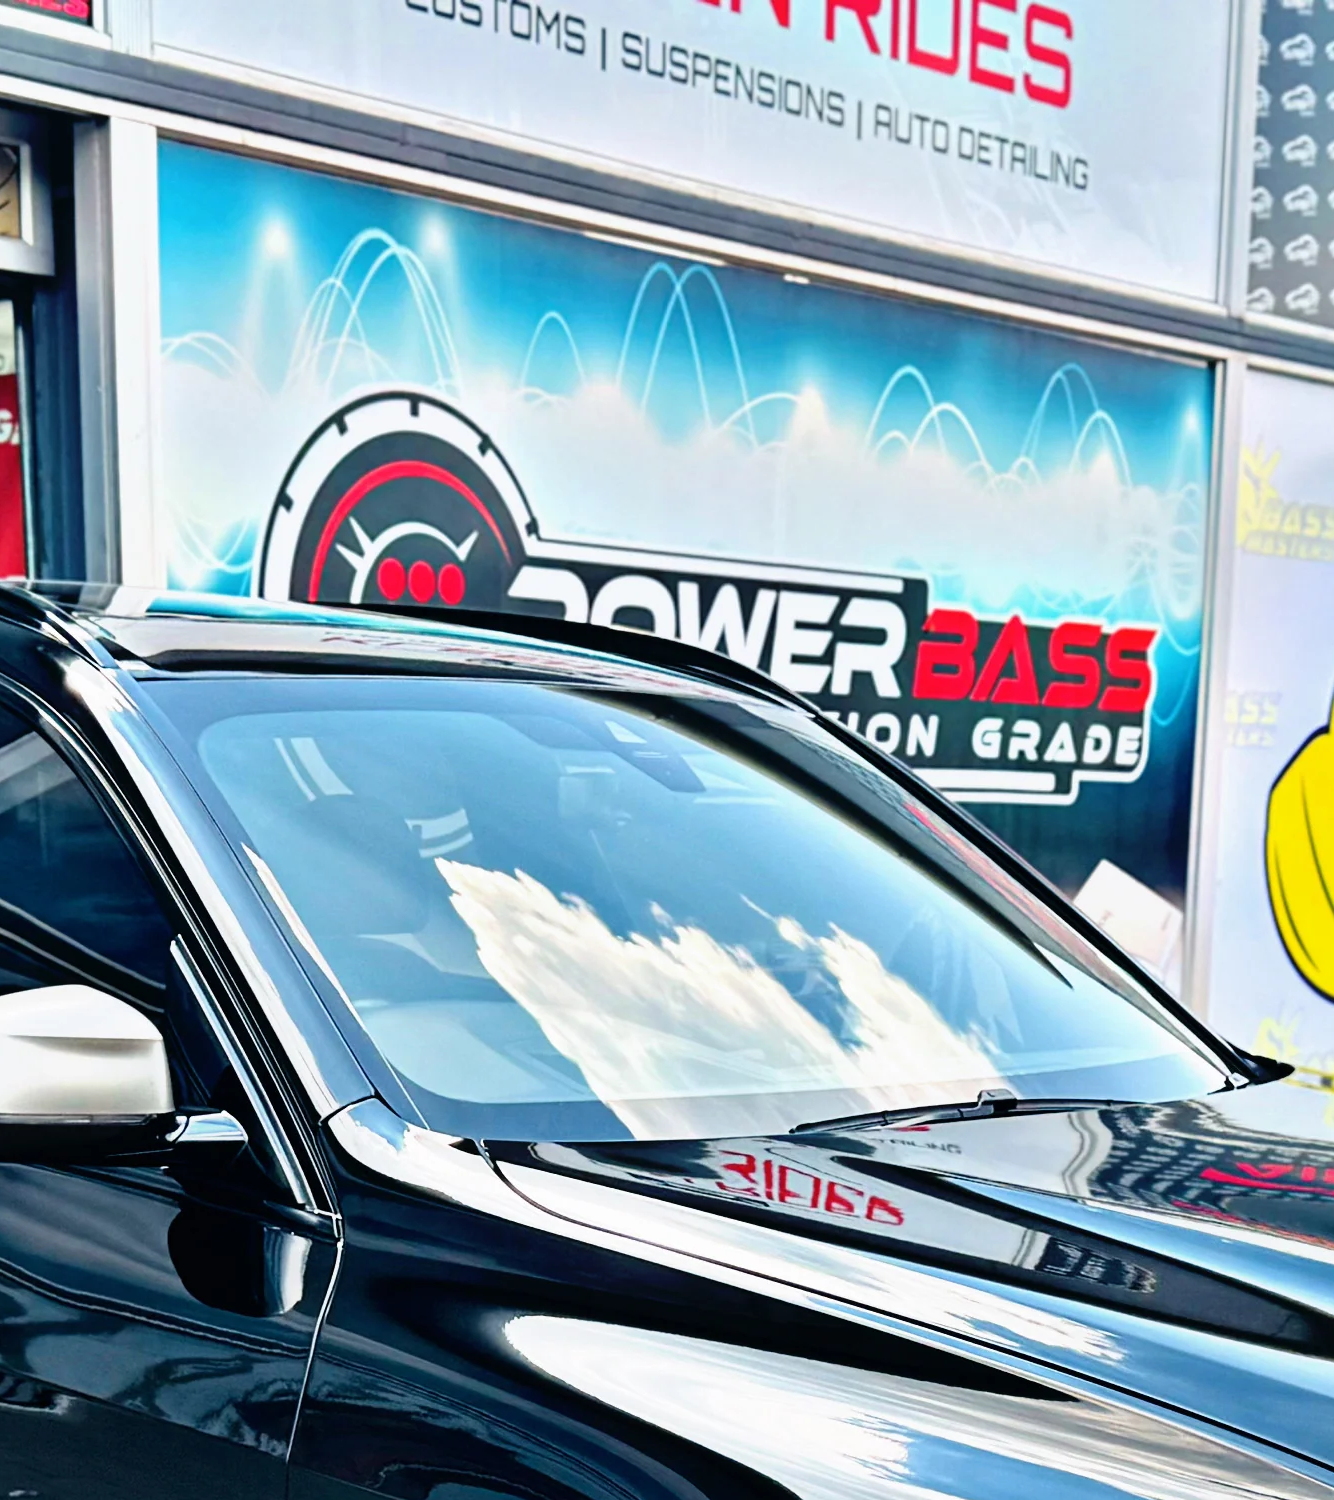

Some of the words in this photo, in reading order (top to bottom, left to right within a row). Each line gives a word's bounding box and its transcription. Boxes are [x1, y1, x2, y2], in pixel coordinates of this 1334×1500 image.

[621, 32, 845, 128] SUSPENSIONS
[873, 103, 950, 155] AUTO
[957, 125, 1089, 191] DETAILING
[971, 717, 1144, 767] GRADE
